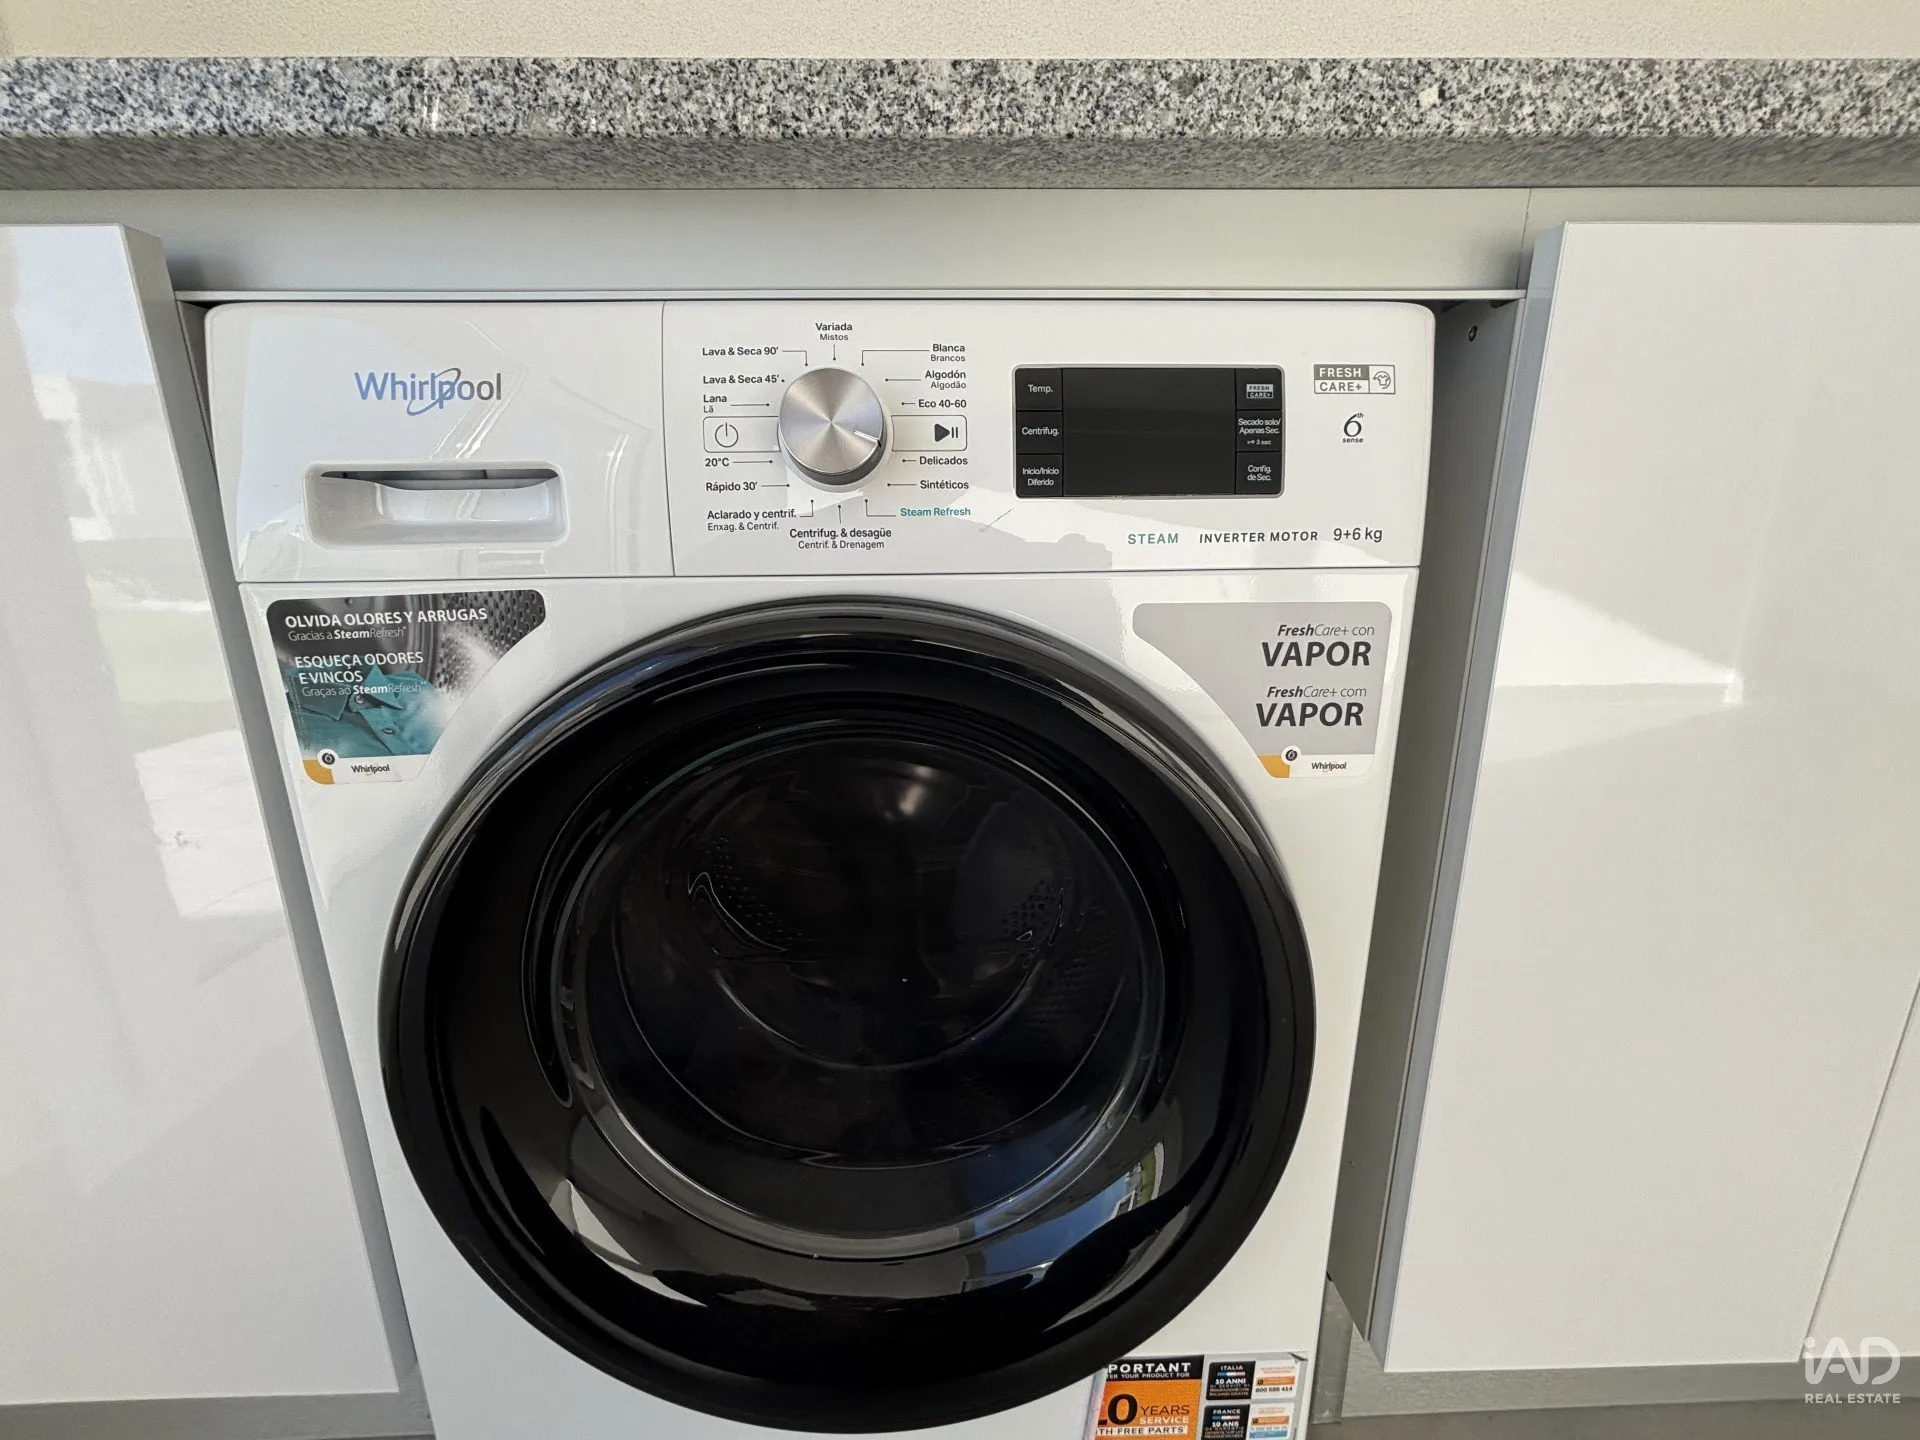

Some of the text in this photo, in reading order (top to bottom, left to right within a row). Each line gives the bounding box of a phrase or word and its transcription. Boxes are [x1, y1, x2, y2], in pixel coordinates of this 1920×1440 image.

[815, 322, 853, 332] Variada
[819, 333, 849, 341] Mistos
[702, 347, 726, 356] Lava
[728, 347, 735, 356] &
[737, 347, 762, 356] Seca
[932, 343, 966, 352] Blanca
[930, 354, 966, 362] Brancos
[925, 370, 966, 381] Algodón
[1319, 367, 1362, 378] FRESH
[703, 375, 726, 385] Lava
[728, 375, 736, 384] &
[737, 375, 763, 384] Seca
[354, 370, 502, 412] Whirlpool
[930, 381, 967, 391] Algodão
[1027, 384, 1053, 395] Temp.
[1319, 381, 1362, 392] CARE+
[703, 394, 728, 403] Lana
[918, 399, 967, 408] Eco 40-60
[703, 405, 714, 413] Lã
[1238, 418, 1264, 426] Secado
[1021, 426, 1060, 437] Centrifug.
[1239, 427, 1265, 436] Apenas
[705, 458, 730, 467] 20°C
[919, 456, 968, 465] Delicados
[1247, 465, 1272, 474] Config.
[706, 482, 741, 493] Rápido
[920, 480, 970, 490] Sintéticos
[1027, 478, 1055, 486] Diferido
[707, 509, 797, 520] Aclarado y centrif.
[900, 507, 971, 516] Steam Refresh
[707, 521, 779, 532] Enxag. & Centrif.
[789, 527, 892, 540] Centrifug. & desagüe
[1127, 533, 1179, 545] STEAM
[1199, 531, 1318, 544] INVERTER MOTOR
[1333, 527, 1383, 543] 9+6 kg
[798, 540, 885, 550] Centrif. & Drenagem
[285, 607, 488, 628] OLVIDA OLORES Y ARRUGAS
[288, 630, 325, 641] Gracias
[326, 631, 333, 640] a
[1277, 624, 1375, 636] FreshCare+ con
[1261, 641, 1372, 667] VAPOR
[295, 651, 424, 670] ESQUEÇA ODORES
[298, 670, 363, 685] E VINCOS
[302, 687, 337, 699] Graças
[338, 686, 352, 696] ao
[1267, 685, 1367, 698] FreshCare+ com
[1256, 702, 1364, 727] VAPOR
[351, 764, 391, 774] Whirlpool
[1311, 762, 1347, 772] Whirlpool
[1108, 1362, 1191, 1374] PORTANT
[1098, 1393, 1138, 1426] 0
[1140, 1405, 1190, 1416] YEARS
[1140, 1416, 1189, 1425] SERVICE
[1148, 1426, 1184, 1434] PARTS
